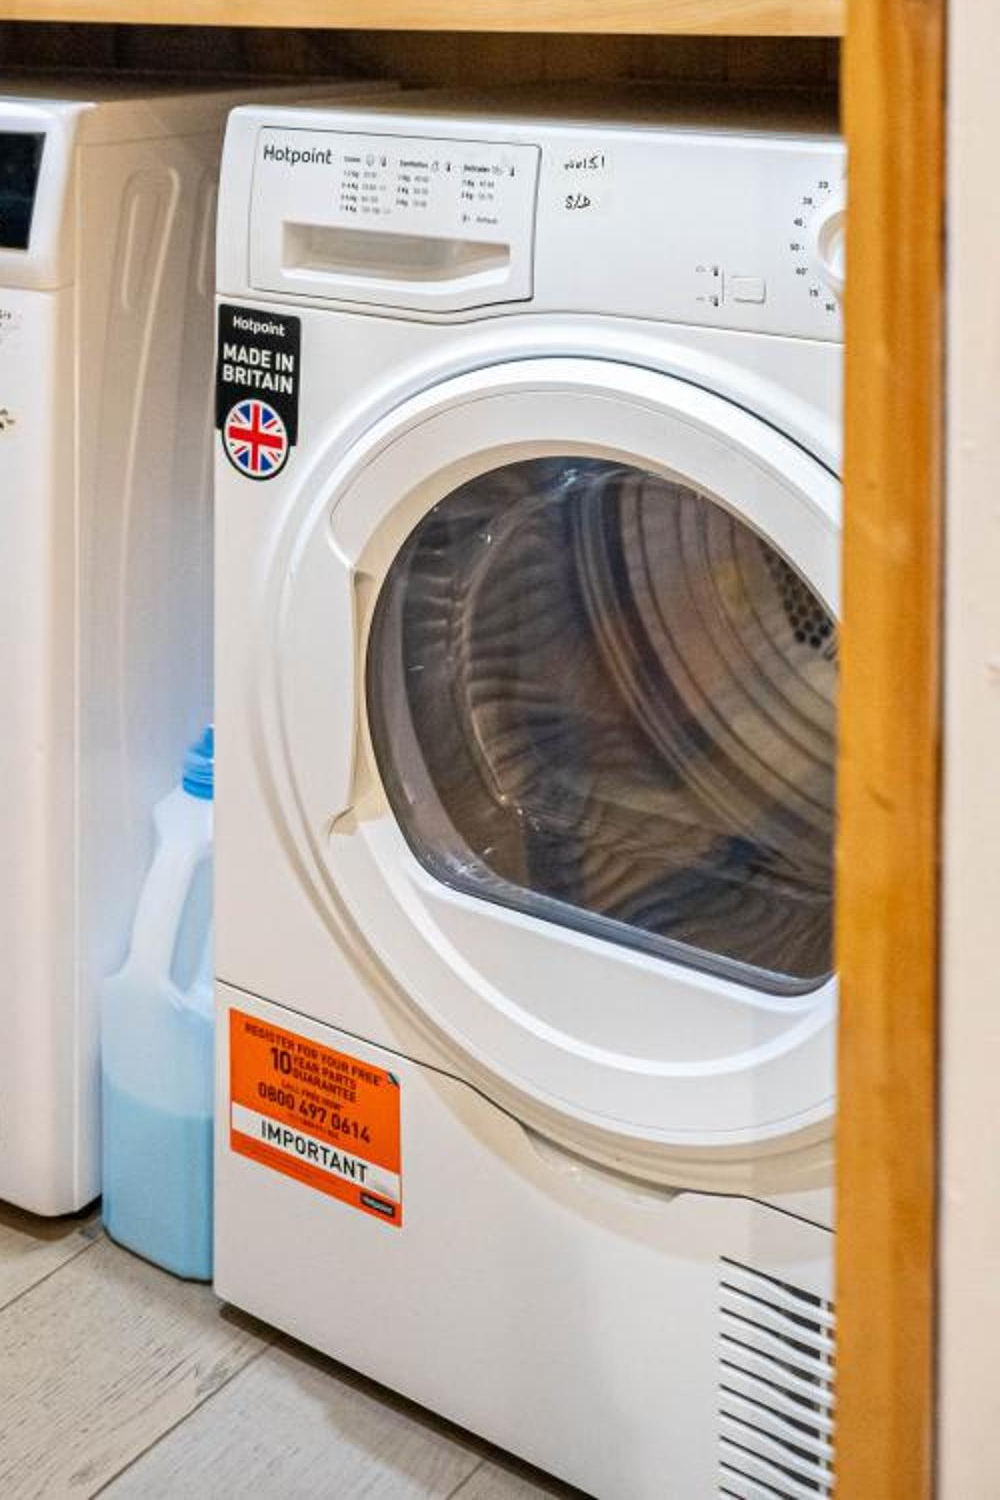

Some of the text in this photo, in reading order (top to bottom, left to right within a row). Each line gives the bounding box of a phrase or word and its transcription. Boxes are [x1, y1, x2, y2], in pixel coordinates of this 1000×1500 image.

[263, 144, 332, 166] Hotpoint
[233, 315, 286, 337] Hotpoint
[223, 342, 294, 373] MADE IN
[222, 364, 293, 394] BRITAIN
[245, 1021, 381, 1087] REGISTER FOR YOUR FREE
[270, 1046, 293, 1075] 10
[292, 1067, 357, 1102] GUARANTEE
[293, 1054, 357, 1089] YEAR PARTS
[257, 1081, 295, 1112] 0800
[298, 1098, 328, 1124] 497
[330, 1113, 370, 1144] 0614
[260, 1119, 368, 1183] IMPORTANT
